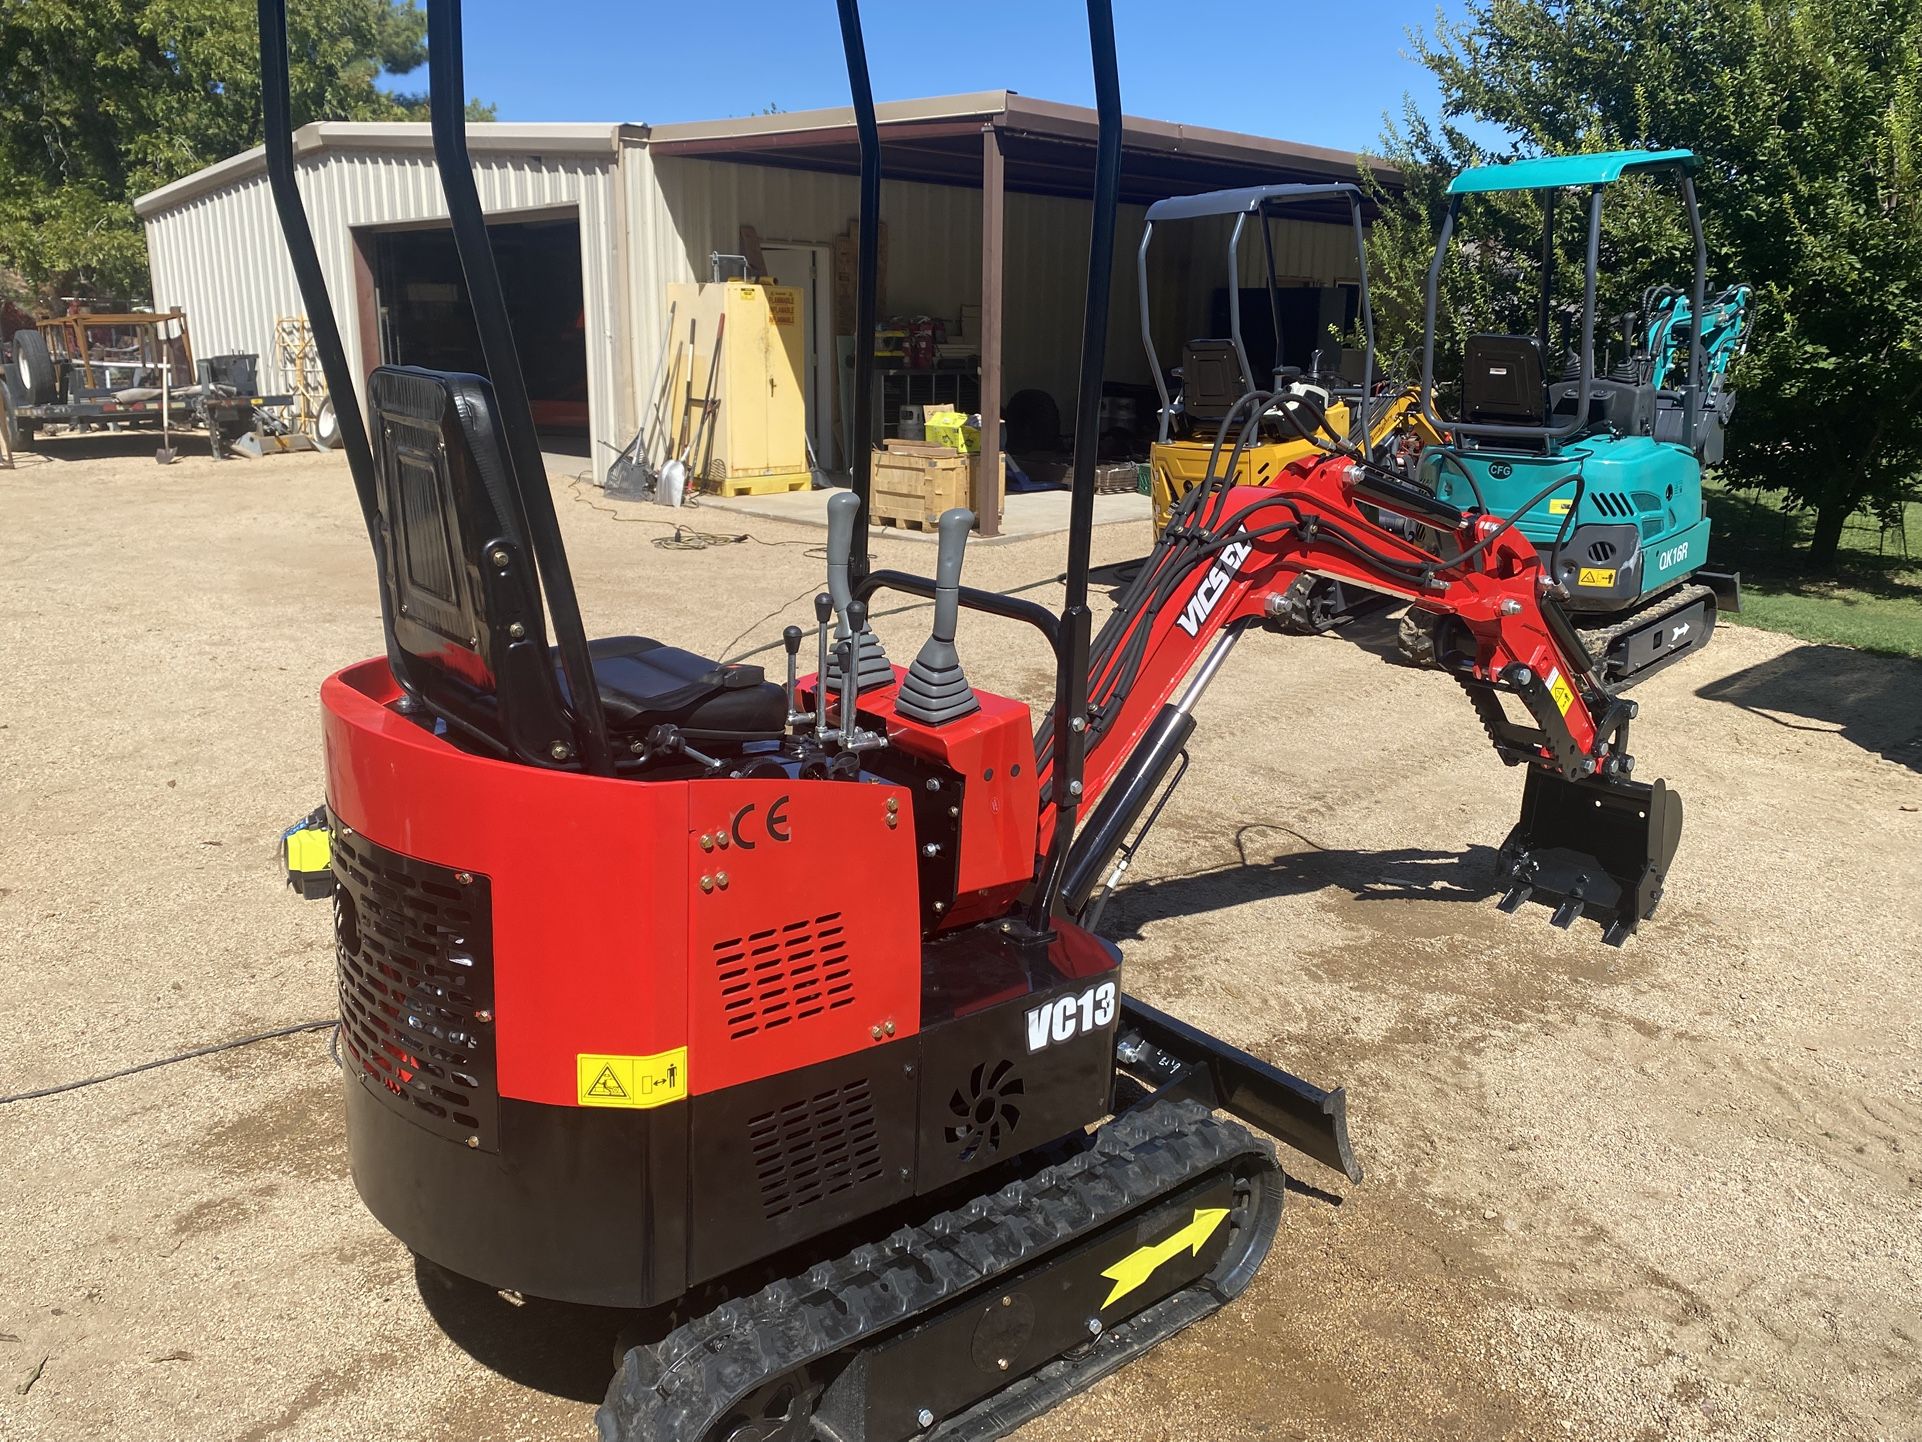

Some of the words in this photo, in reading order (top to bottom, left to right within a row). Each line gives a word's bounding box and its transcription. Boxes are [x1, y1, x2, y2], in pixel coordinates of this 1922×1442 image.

[1490, 464, 1511, 476] CFG
[732, 795, 789, 850] CE
[1028, 982, 1116, 1051] VC13
